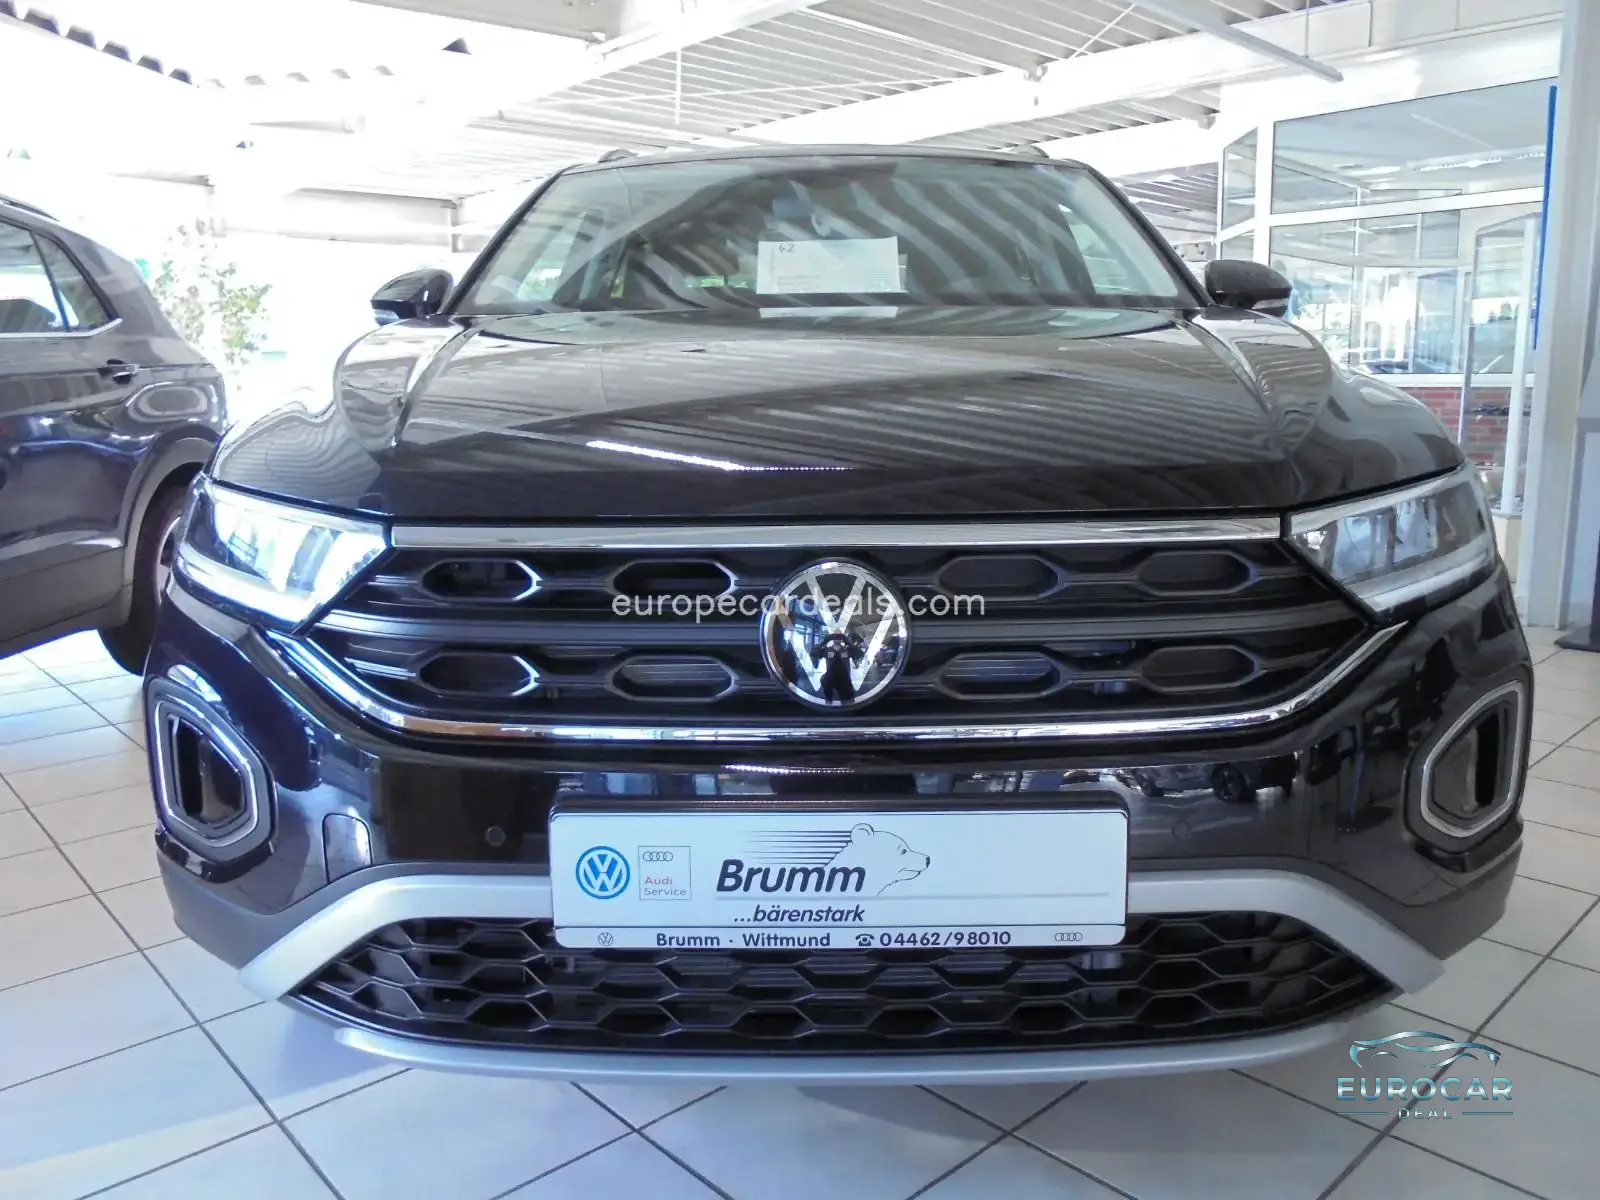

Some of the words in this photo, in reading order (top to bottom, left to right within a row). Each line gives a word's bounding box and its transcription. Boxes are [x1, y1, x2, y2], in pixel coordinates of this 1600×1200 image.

[644, 876, 673, 886] Audi
[717, 859, 865, 893] Brumm
[643, 888, 687, 897] Service
[734, 904, 866, 924] ...bärenstark
[656, 932, 721, 948] Brumm
[742, 932, 831, 948] Wittmund
[880, 931, 1011, 948] 04462/98010
